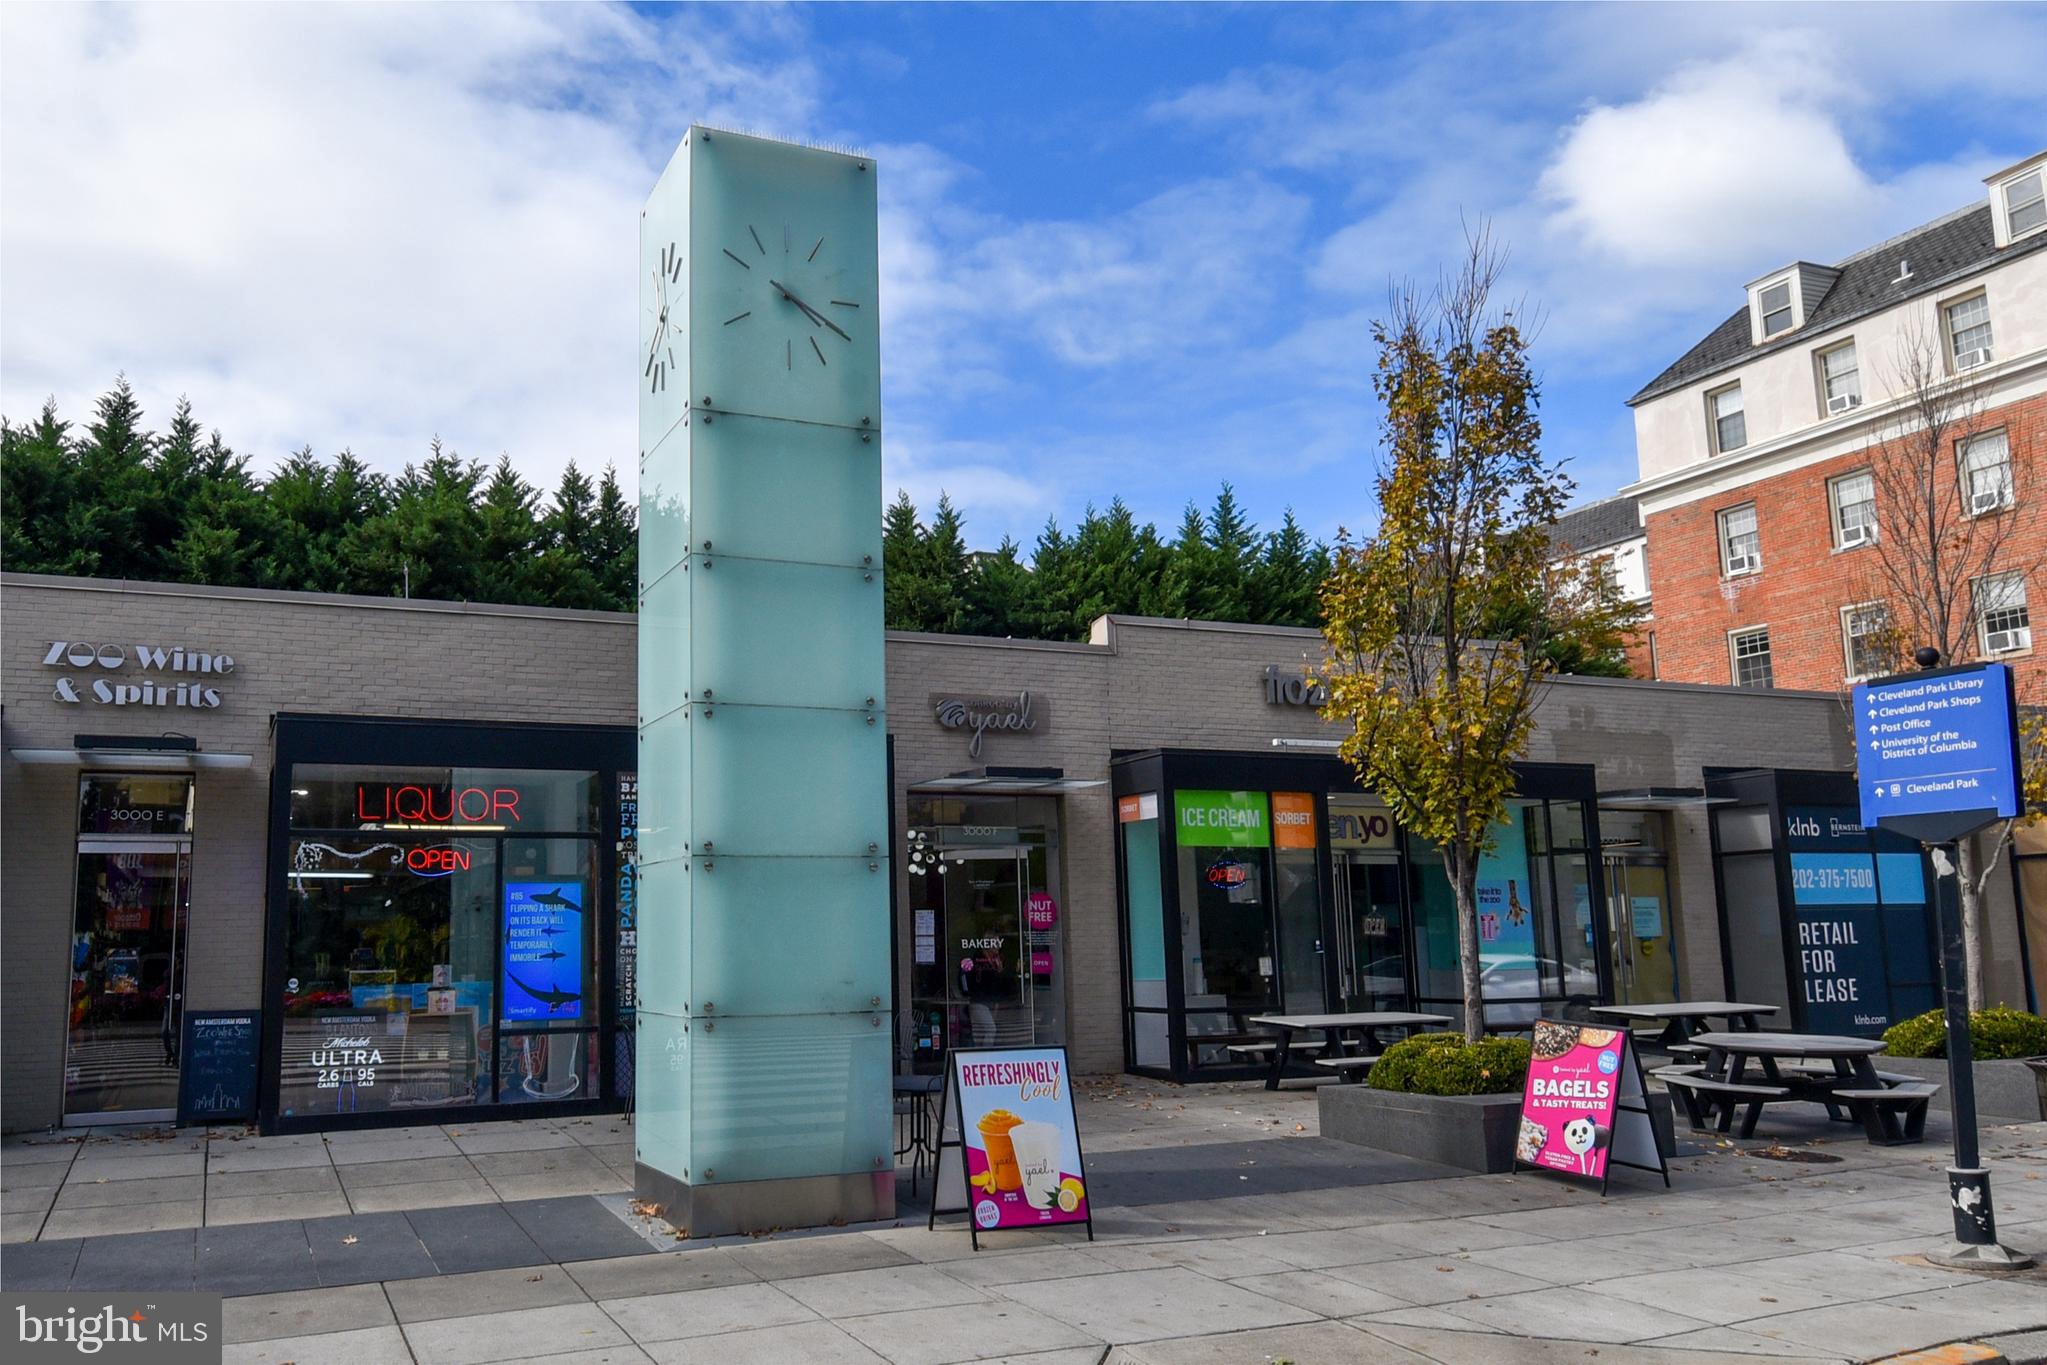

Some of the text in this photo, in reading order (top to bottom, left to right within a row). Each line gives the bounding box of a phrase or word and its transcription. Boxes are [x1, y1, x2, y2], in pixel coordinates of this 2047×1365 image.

[135, 646, 234, 674] Wine
[53, 677, 221, 708] & Spirits
[1878, 679, 1984, 702] Cleveland Park Library
[1880, 696, 1981, 717] Cleveland Park Shops
[969, 690, 1037, 757] yael
[1881, 719, 1931, 733] Post Office
[1882, 731, 1959, 749] University of the
[1882, 740, 1977, 759] District of Columbia
[1906, 780, 1954, 794] Cleveland
[1956, 777, 1979, 788] Park
[359, 786, 521, 822] LIQUOR
[110, 809, 163, 821] 3000 E
[1182, 808, 1260, 828] ICE CREAM
[1275, 812, 1311, 825] SORBET
[963, 826, 992, 836] 3000
[1787, 816, 1820, 836] klnb
[407, 848, 471, 870] OPEN
[1208, 869, 1246, 883] OPEN
[1792, 868, 1873, 889] 202-375-7500
[621, 864, 632, 929] PANDA
[510, 904, 566, 912] FLIPPING A SHARK
[1029, 900, 1052, 911] NUT
[510, 915, 564, 925] ON ITS BACK WILL
[1029, 911, 1052, 922] FREE
[510, 928, 535, 937] RENDER
[1799, 921, 1858, 945] RETAIL
[510, 940, 553, 950] TEMPORARILY
[961, 938, 1004, 949] BAKERY
[1801, 949, 1836, 973] FOR
[1804, 978, 1858, 1003] LEASE
[1854, 1014, 1887, 1025] klnb.com
[322, 1036, 372, 1049] Michelob
[312, 1049, 384, 1066] ULTRA
[1600, 1061, 1614, 1070] FREE
[1602, 1055, 1614, 1063] NUT
[318, 1067, 375, 1082] 2.6 95
[962, 1061, 1059, 1087] REFRESHINGLY
[1020, 1075, 1061, 1101] Cool
[1532, 1078, 1609, 1098] BAGELS
[1533, 1099, 1607, 1110] & TASTY TREATS!
[1025, 1158, 1049, 1186] yael
